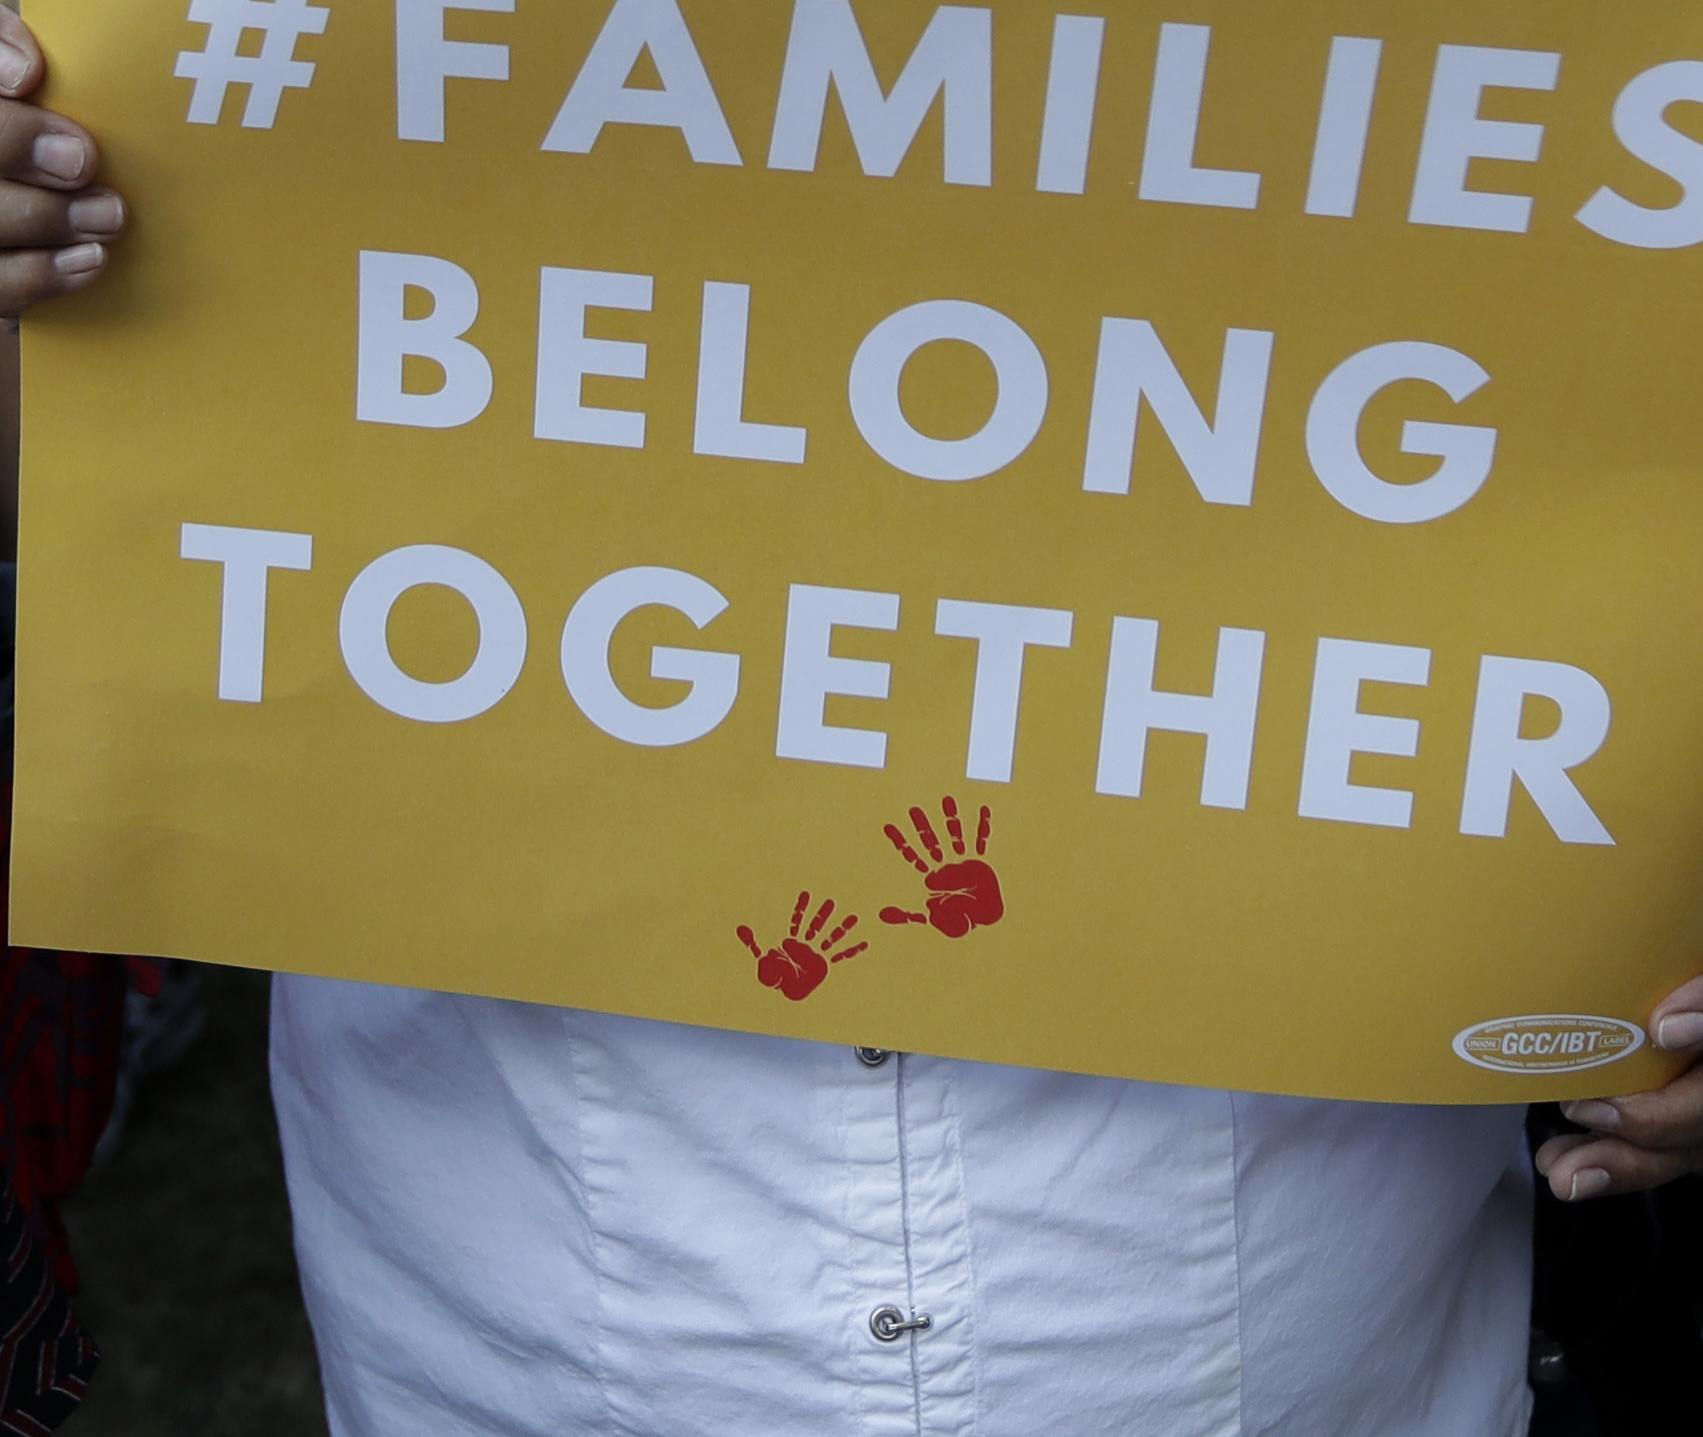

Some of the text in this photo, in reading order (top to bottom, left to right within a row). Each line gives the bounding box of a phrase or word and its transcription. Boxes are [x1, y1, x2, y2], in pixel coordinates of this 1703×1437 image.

[353, 249, 1499, 525] BELONG
[179, 522, 1618, 847] TOGETHER
[1501, 1031, 1602, 1055] GCC/IBT
[1603, 1035, 1630, 1045] LABEL
